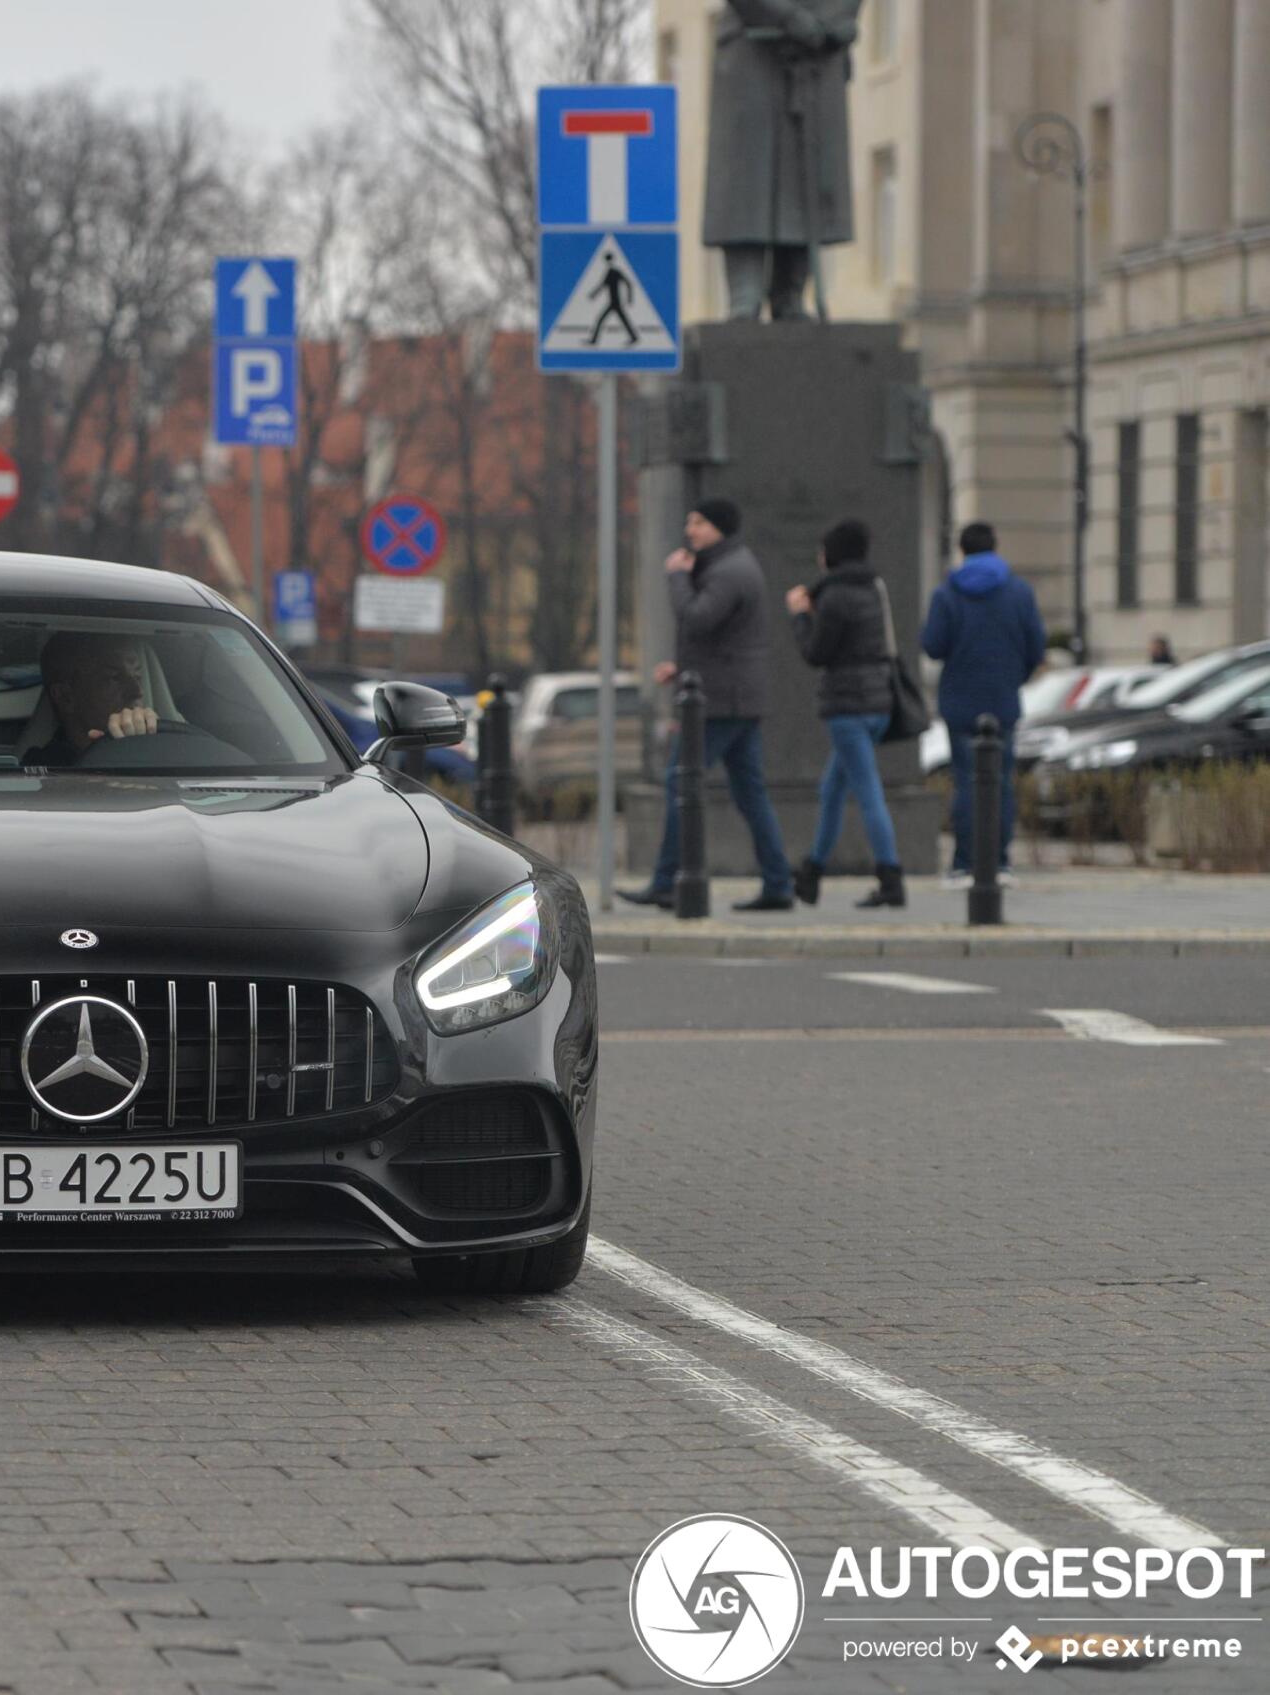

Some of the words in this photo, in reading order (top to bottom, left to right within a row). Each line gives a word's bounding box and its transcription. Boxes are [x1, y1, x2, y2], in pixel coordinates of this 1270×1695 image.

[232, 348, 283, 418] P
[59, 1150, 227, 1203] 4225U
[17, 1212, 78, 1222] Performance
[80, 1212, 112, 1221] Center
[115, 1211, 162, 1221] Warszawa
[179, 1211, 191, 1220] 22
[193, 1210, 209, 1219] 312
[212, 1209, 235, 1219] 7000
